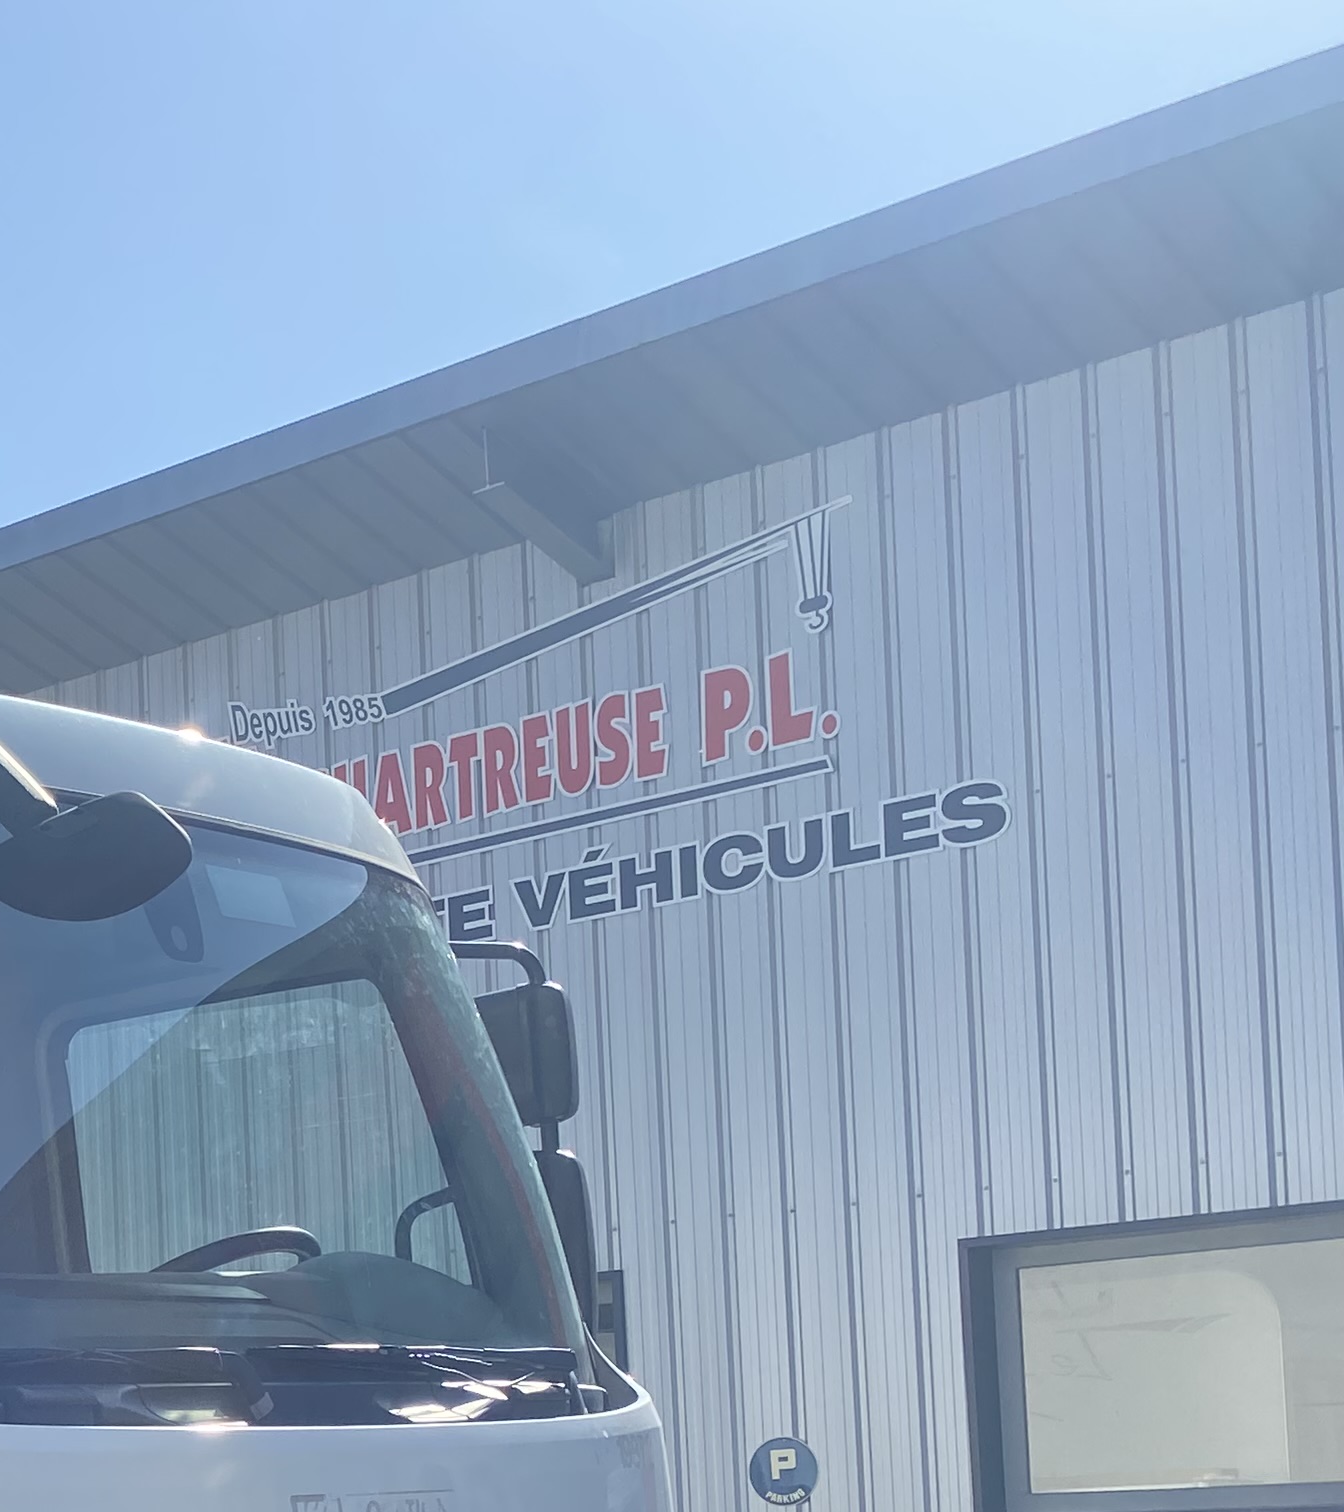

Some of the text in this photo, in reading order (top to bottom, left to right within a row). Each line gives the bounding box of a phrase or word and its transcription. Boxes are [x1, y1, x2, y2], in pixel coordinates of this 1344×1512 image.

[230, 702, 313, 747] Depuis
[325, 696, 383, 728] 1985
[324, 649, 840, 834] ARTREUSE P.L.
[513, 782, 1010, 929] VÉHICULES
[769, 1448, 797, 1480] P
[765, 1486, 806, 1504] PARKING
